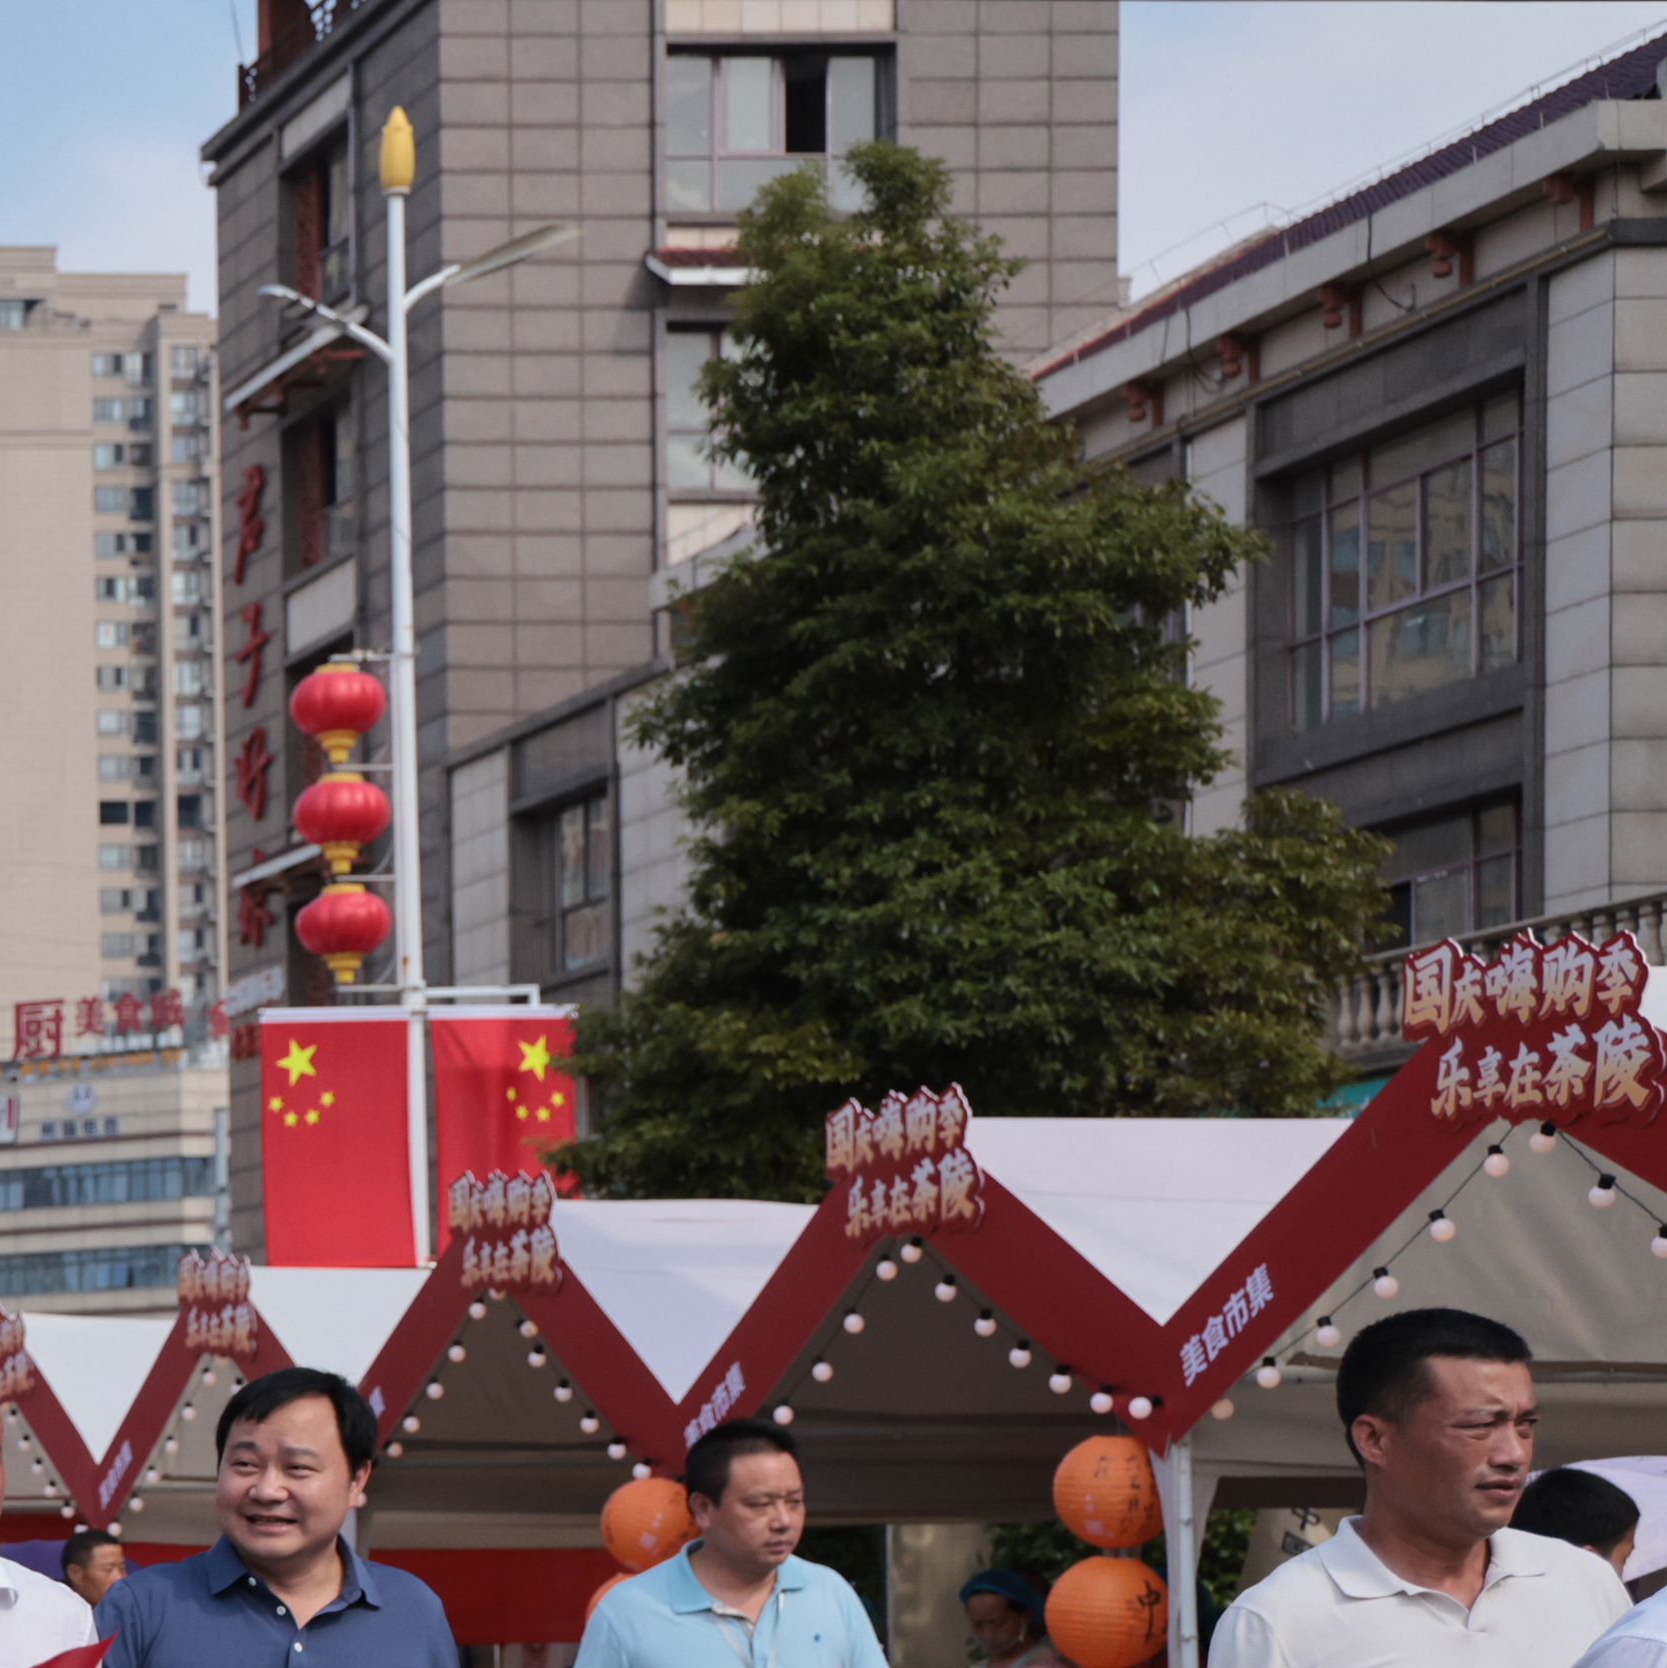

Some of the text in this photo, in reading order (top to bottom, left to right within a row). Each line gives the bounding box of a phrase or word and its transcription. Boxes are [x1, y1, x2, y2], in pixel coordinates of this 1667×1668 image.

[1405, 939, 1639, 1032] 国庆嗨购季
[1430, 1014, 1651, 1119] 乐享在茶陵
[825, 1089, 964, 1173] 国庆嗨购季
[844, 1147, 975, 1238] 乐享在茶陵
[1178, 1262, 1275, 1387] 美食市集
